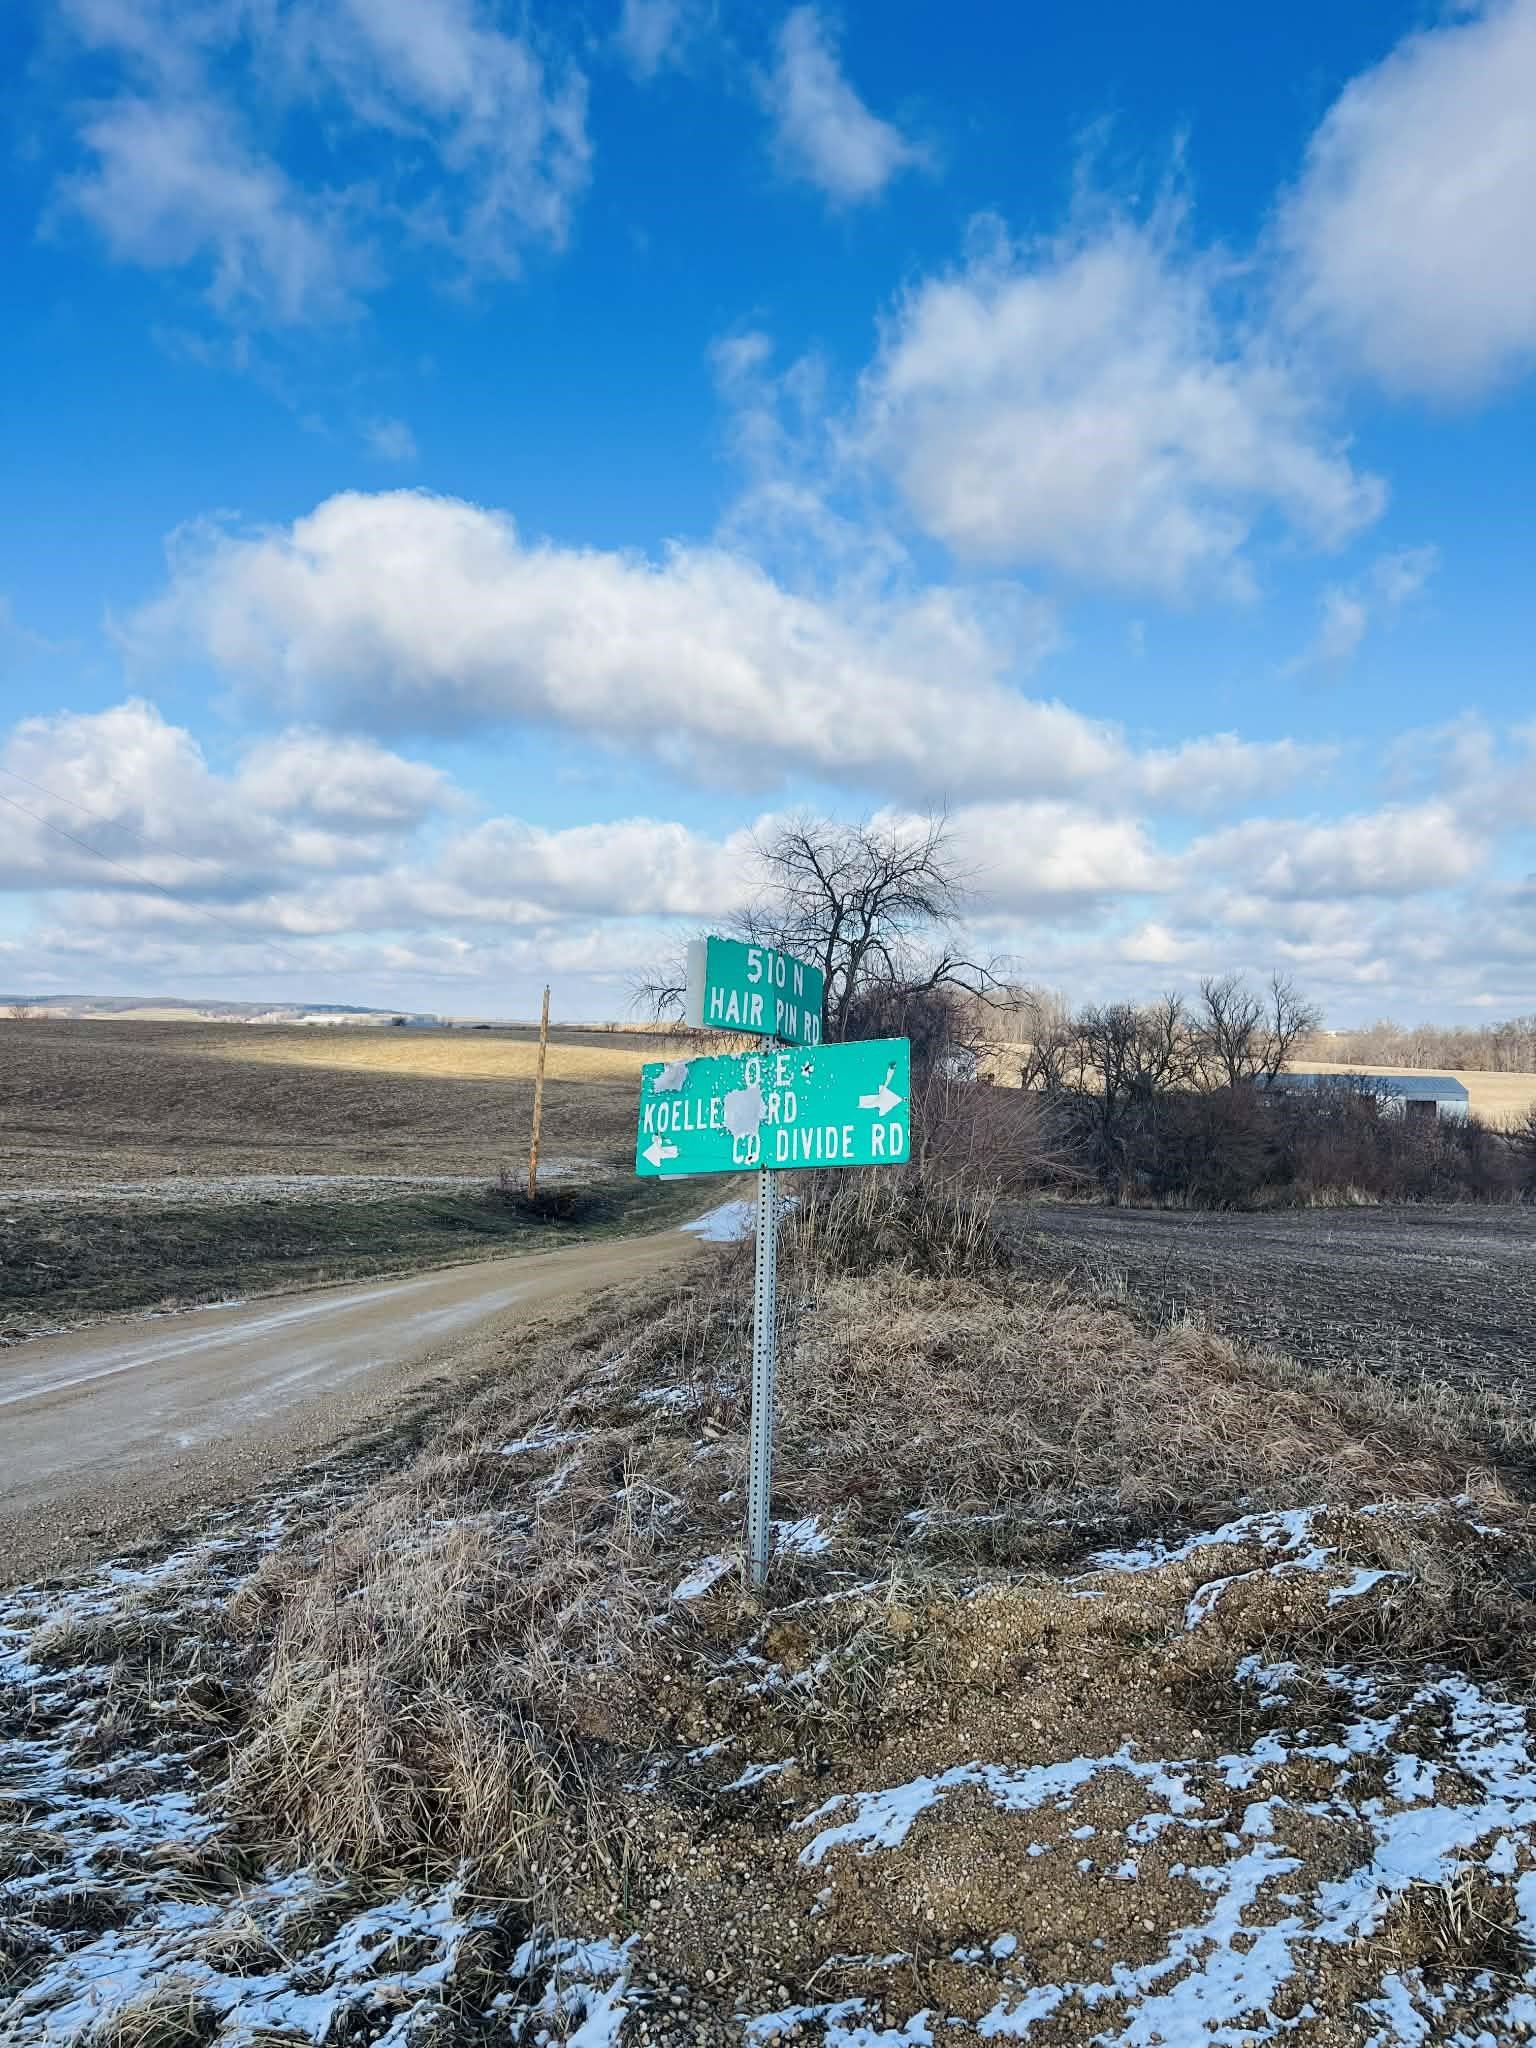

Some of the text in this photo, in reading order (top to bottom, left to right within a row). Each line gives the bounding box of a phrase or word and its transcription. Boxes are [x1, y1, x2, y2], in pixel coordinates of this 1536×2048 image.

[747, 949, 804, 997] 510 N
[710, 986, 820, 1045] HAIR PIN RD
[776, 1054, 793, 1087] E
[643, 1091, 797, 1134] KOELLE RD
[776, 1124, 855, 1162] DIVIDE
[871, 1122, 903, 1157] RD
